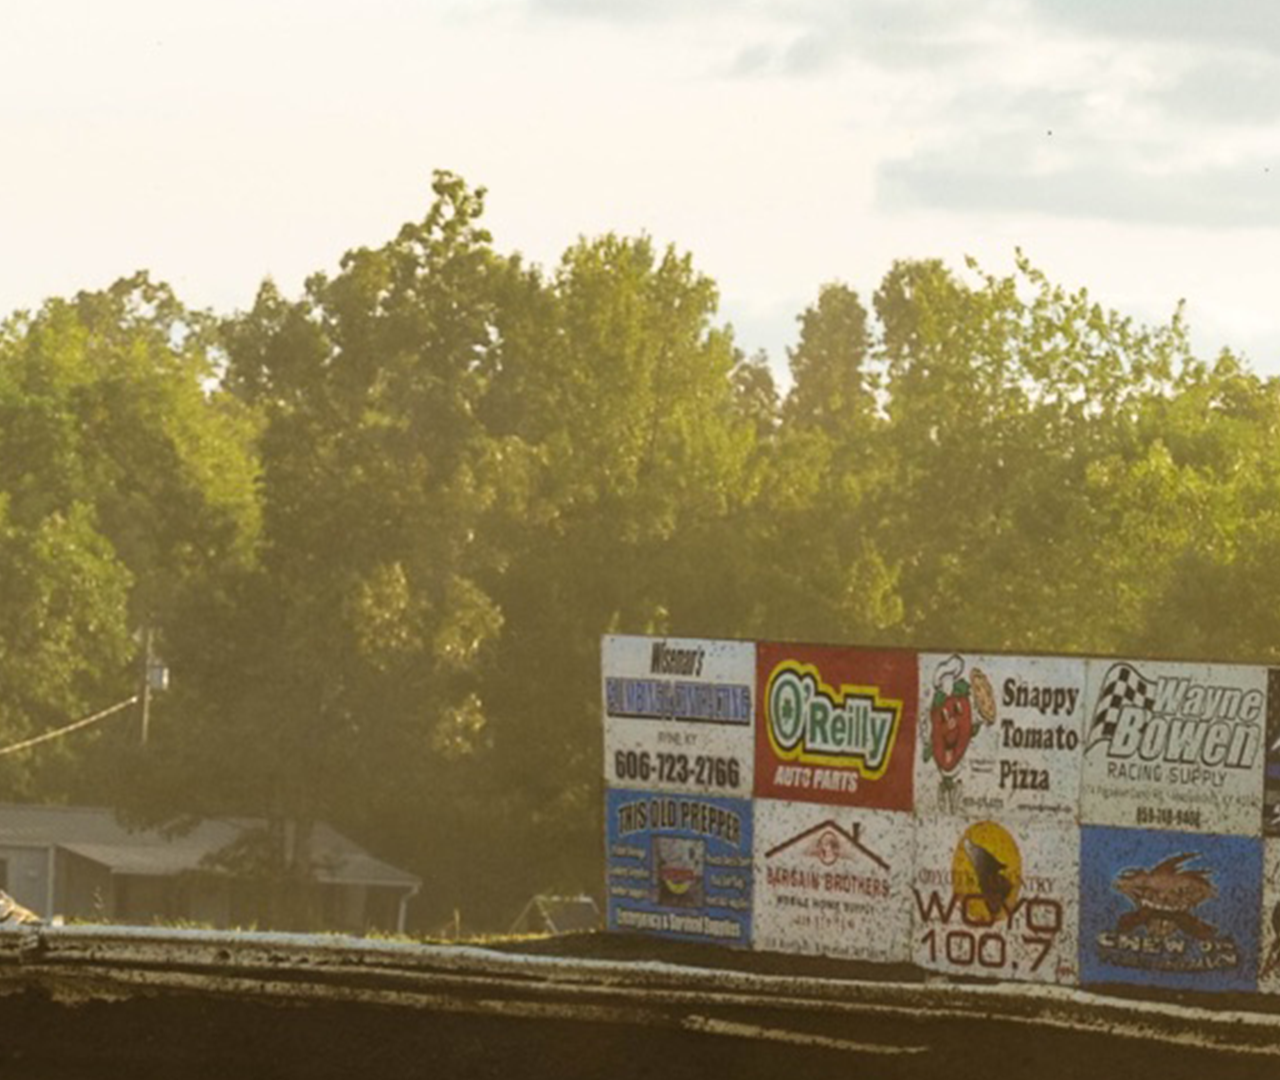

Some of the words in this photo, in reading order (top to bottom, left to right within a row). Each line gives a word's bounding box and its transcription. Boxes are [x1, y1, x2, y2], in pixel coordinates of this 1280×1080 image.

[1002, 678, 1080, 716] Snappy
[1152, 675, 1264, 723] Wayne
[772, 676, 890, 763] O'Reilly
[1000, 718, 1080, 751] Tomato
[1107, 704, 1261, 770] Bowen
[615, 750, 740, 789] 606-723-2766
[773, 765, 811, 788] AUTO
[813, 769, 859, 793] PARTS
[999, 759, 1051, 791] Pizza
[1107, 762, 1162, 783] RACING
[1170, 767, 1227, 788] SUPPLY
[618, 801, 648, 835] THIS
[650, 799, 677, 828] OLD
[680, 801, 741, 846] PREPPER
[766, 866, 820, 891] BARGAIN
[824, 872, 890, 899] BROTHERS
[920, 929, 1054, 972] 100.7
